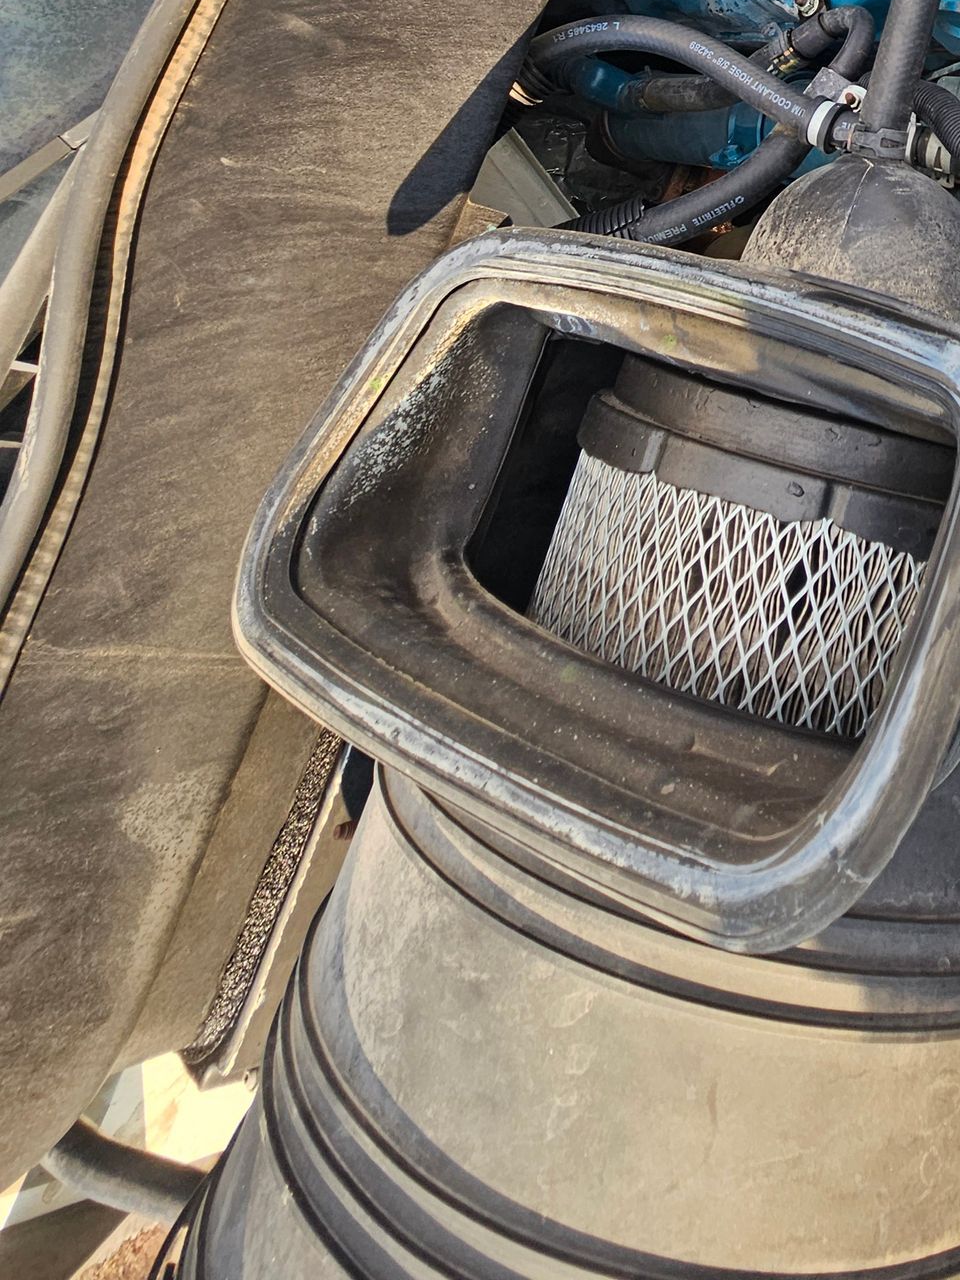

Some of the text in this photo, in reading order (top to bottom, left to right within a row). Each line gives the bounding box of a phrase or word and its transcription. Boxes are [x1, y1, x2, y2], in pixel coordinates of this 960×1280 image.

[552, 31, 566, 43] R1
[567, 21, 609, 38] 2643485
[728, 64, 753, 85] HOSE
[751, 80, 792, 110] COOLANT
[692, 200, 736, 227] FLEETRITE
